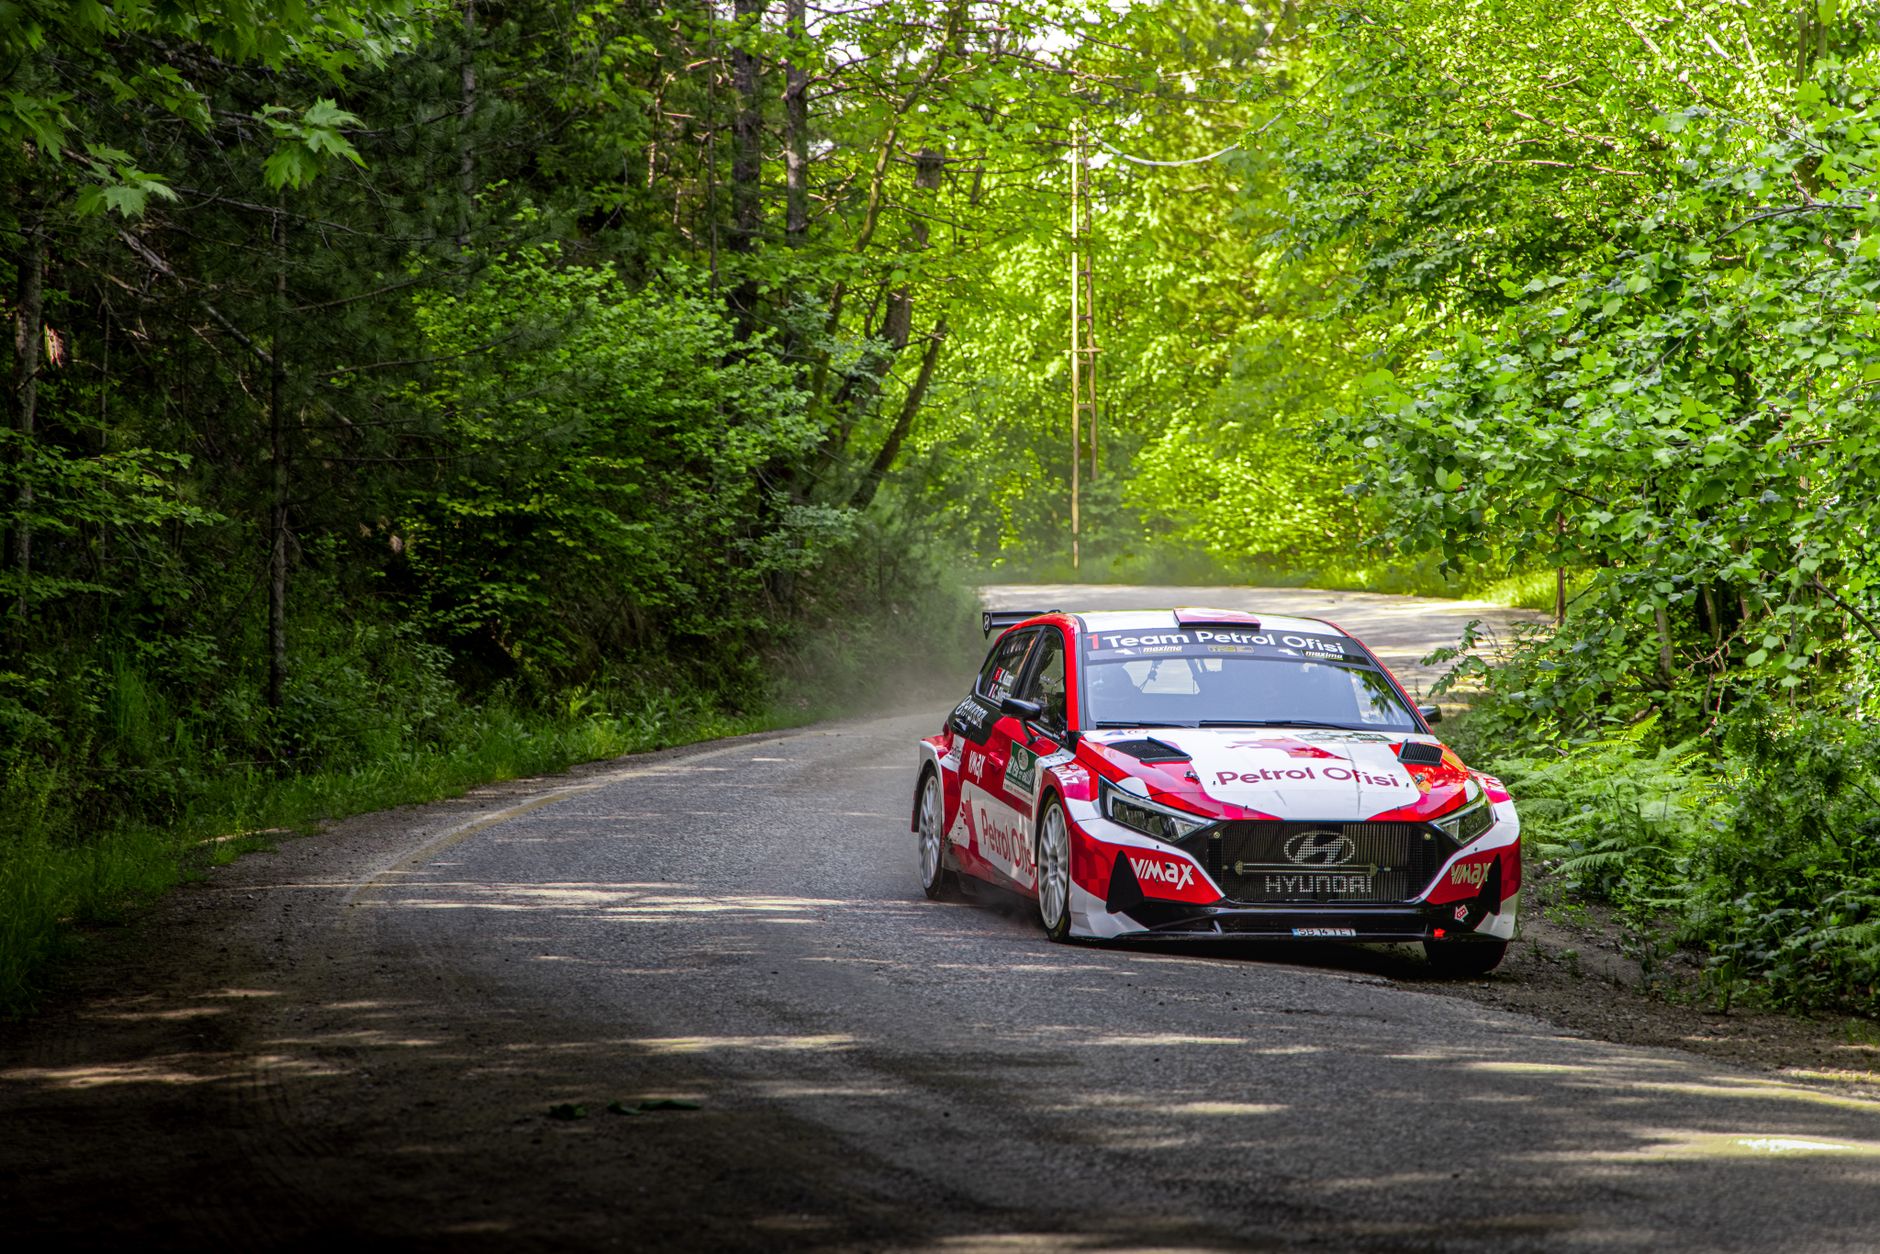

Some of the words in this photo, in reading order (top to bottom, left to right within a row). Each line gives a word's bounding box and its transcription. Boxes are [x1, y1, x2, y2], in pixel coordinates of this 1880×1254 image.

[1087, 634, 1099, 650] 1
[1103, 633, 1190, 648] Team
[1195, 630, 1276, 646] Petrol
[1282, 635, 1345, 654] Ofisi
[1216, 767, 1315, 786] Petrol
[1323, 767, 1399, 787] Ofisi
[981, 808, 1010, 862] Petrol
[1265, 875, 1372, 893] HYUNDAI
